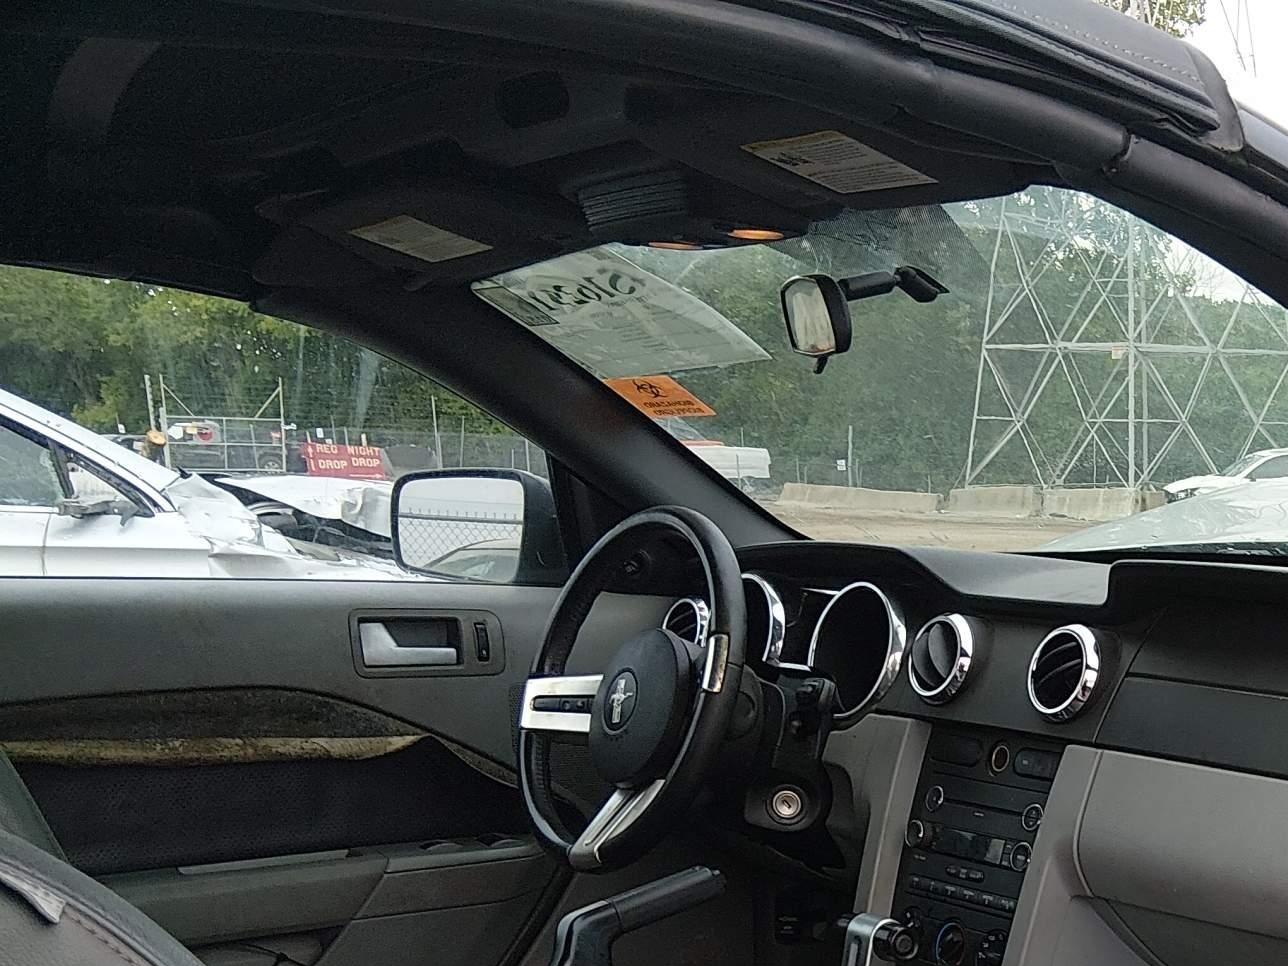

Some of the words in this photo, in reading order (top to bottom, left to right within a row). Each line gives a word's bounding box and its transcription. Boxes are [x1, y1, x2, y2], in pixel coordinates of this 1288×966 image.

[347, 446, 379, 456] NIGHT
[318, 460, 348, 470] DROP
[351, 457, 380, 467] DROP
